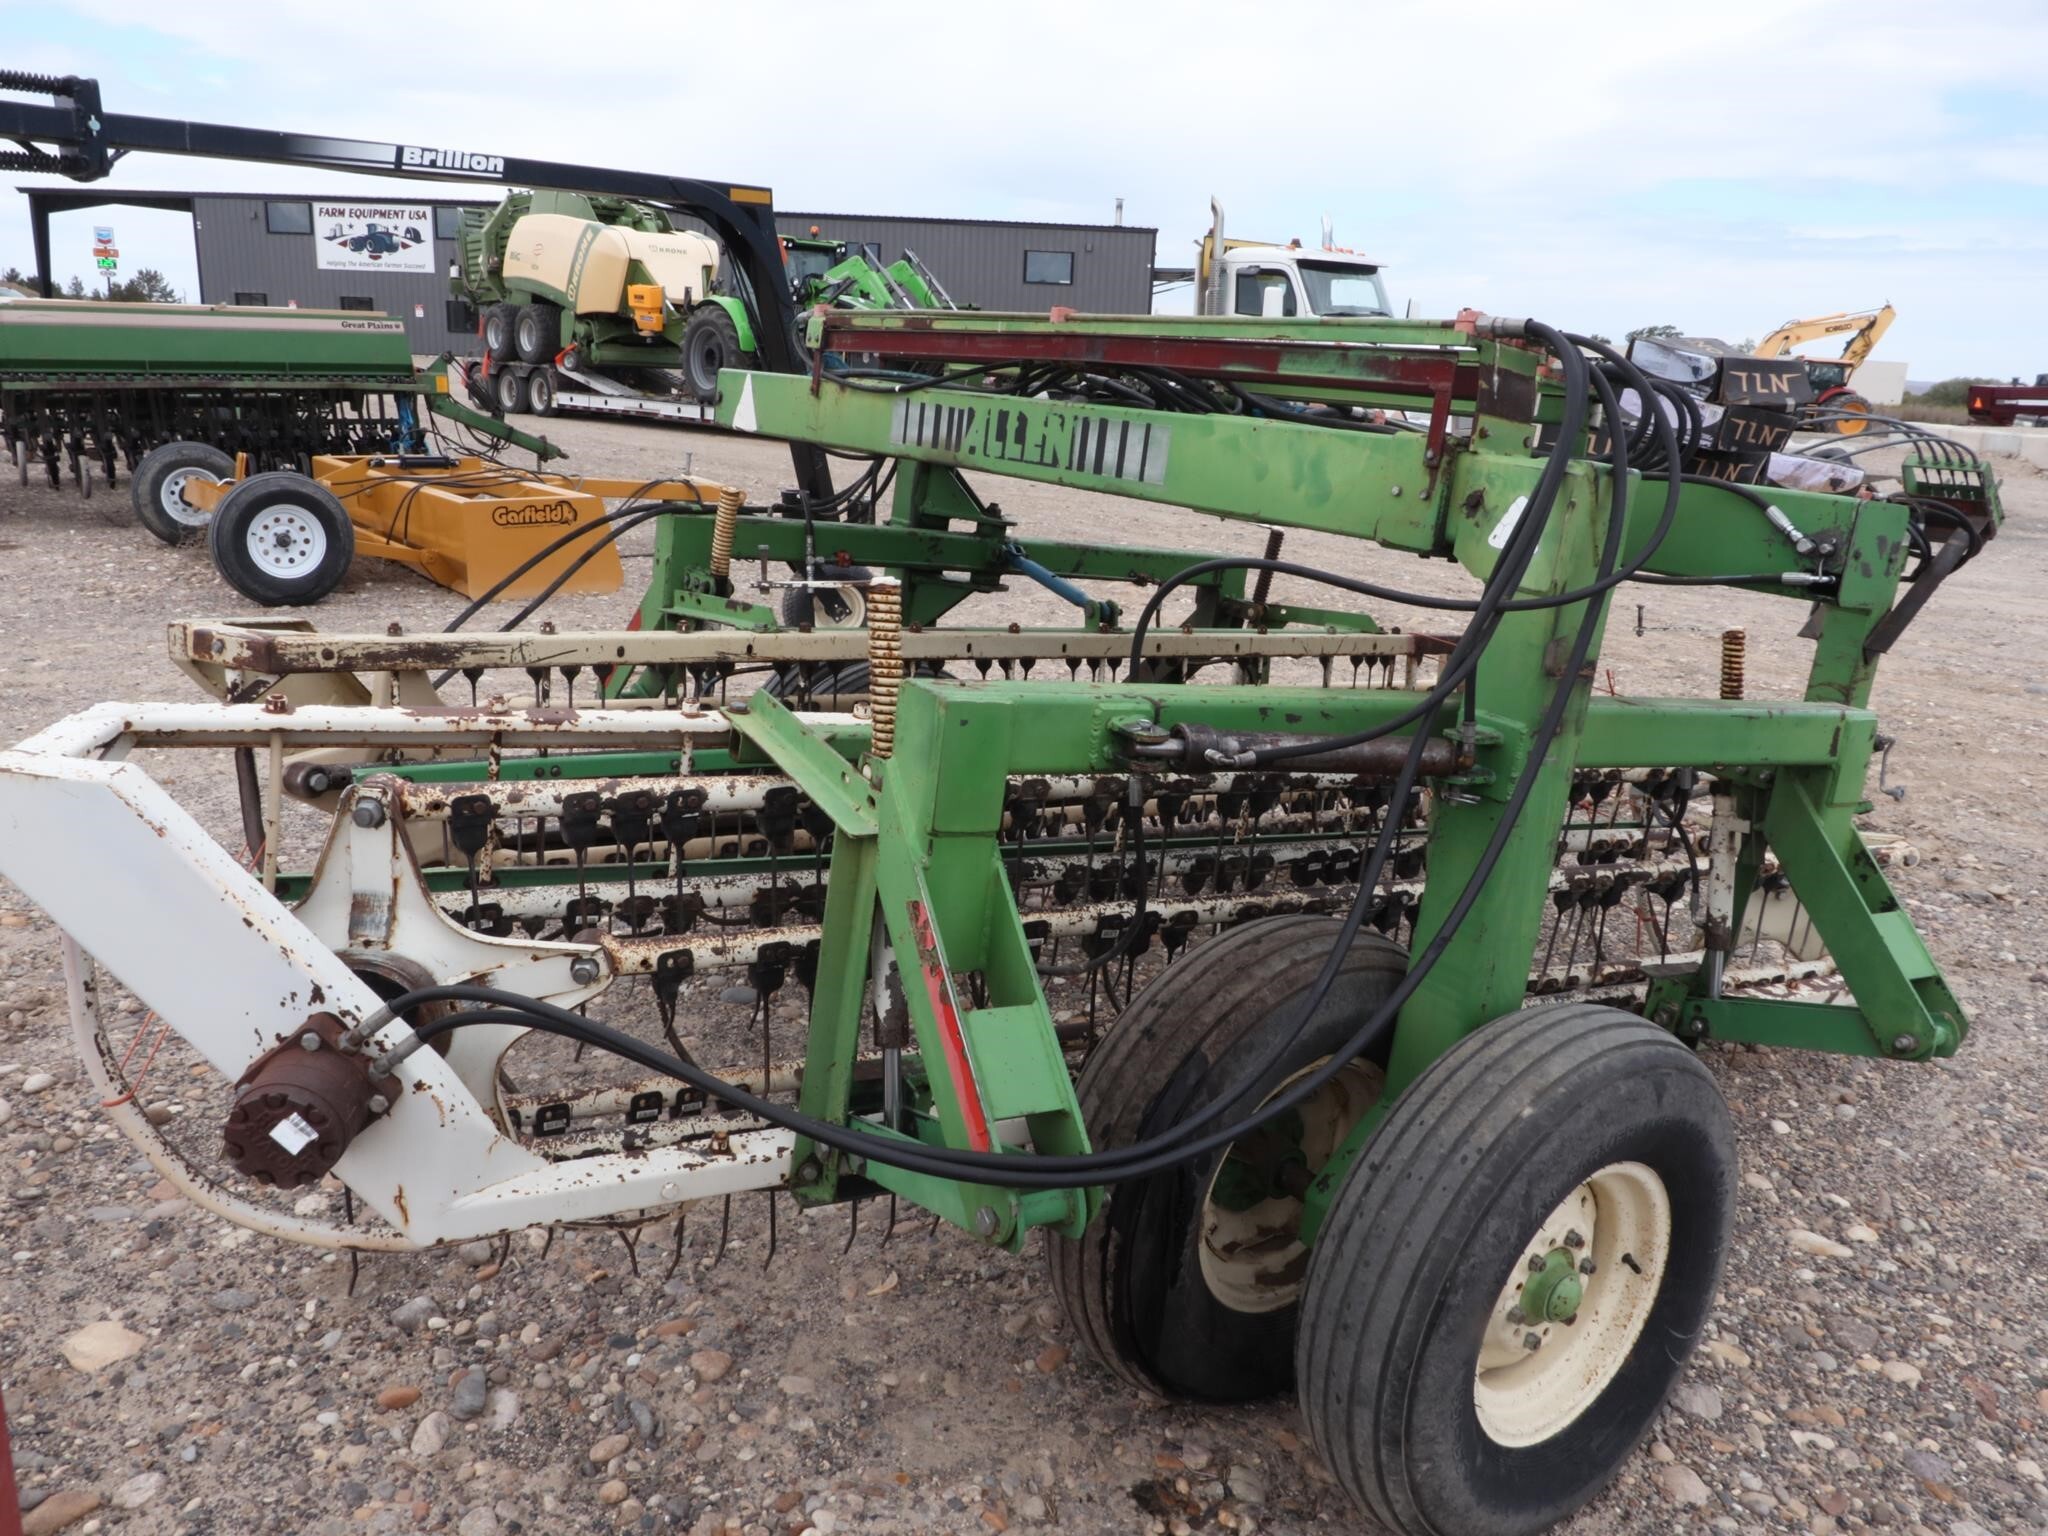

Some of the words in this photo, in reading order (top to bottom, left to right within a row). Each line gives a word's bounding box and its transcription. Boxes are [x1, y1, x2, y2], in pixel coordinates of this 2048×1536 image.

[402, 146, 505, 172] Brillion
[318, 207, 346, 218] FARM
[349, 208, 406, 220] EQUIPMENT
[408, 210, 428, 220] USA
[341, 320, 366, 329] Great
[367, 321, 393, 330] Plains
[1729, 370, 1802, 393] TLN
[958, 406, 1076, 468] ALLEN
[1730, 417, 1790, 446] TLN
[492, 504, 563, 526] Garfield
